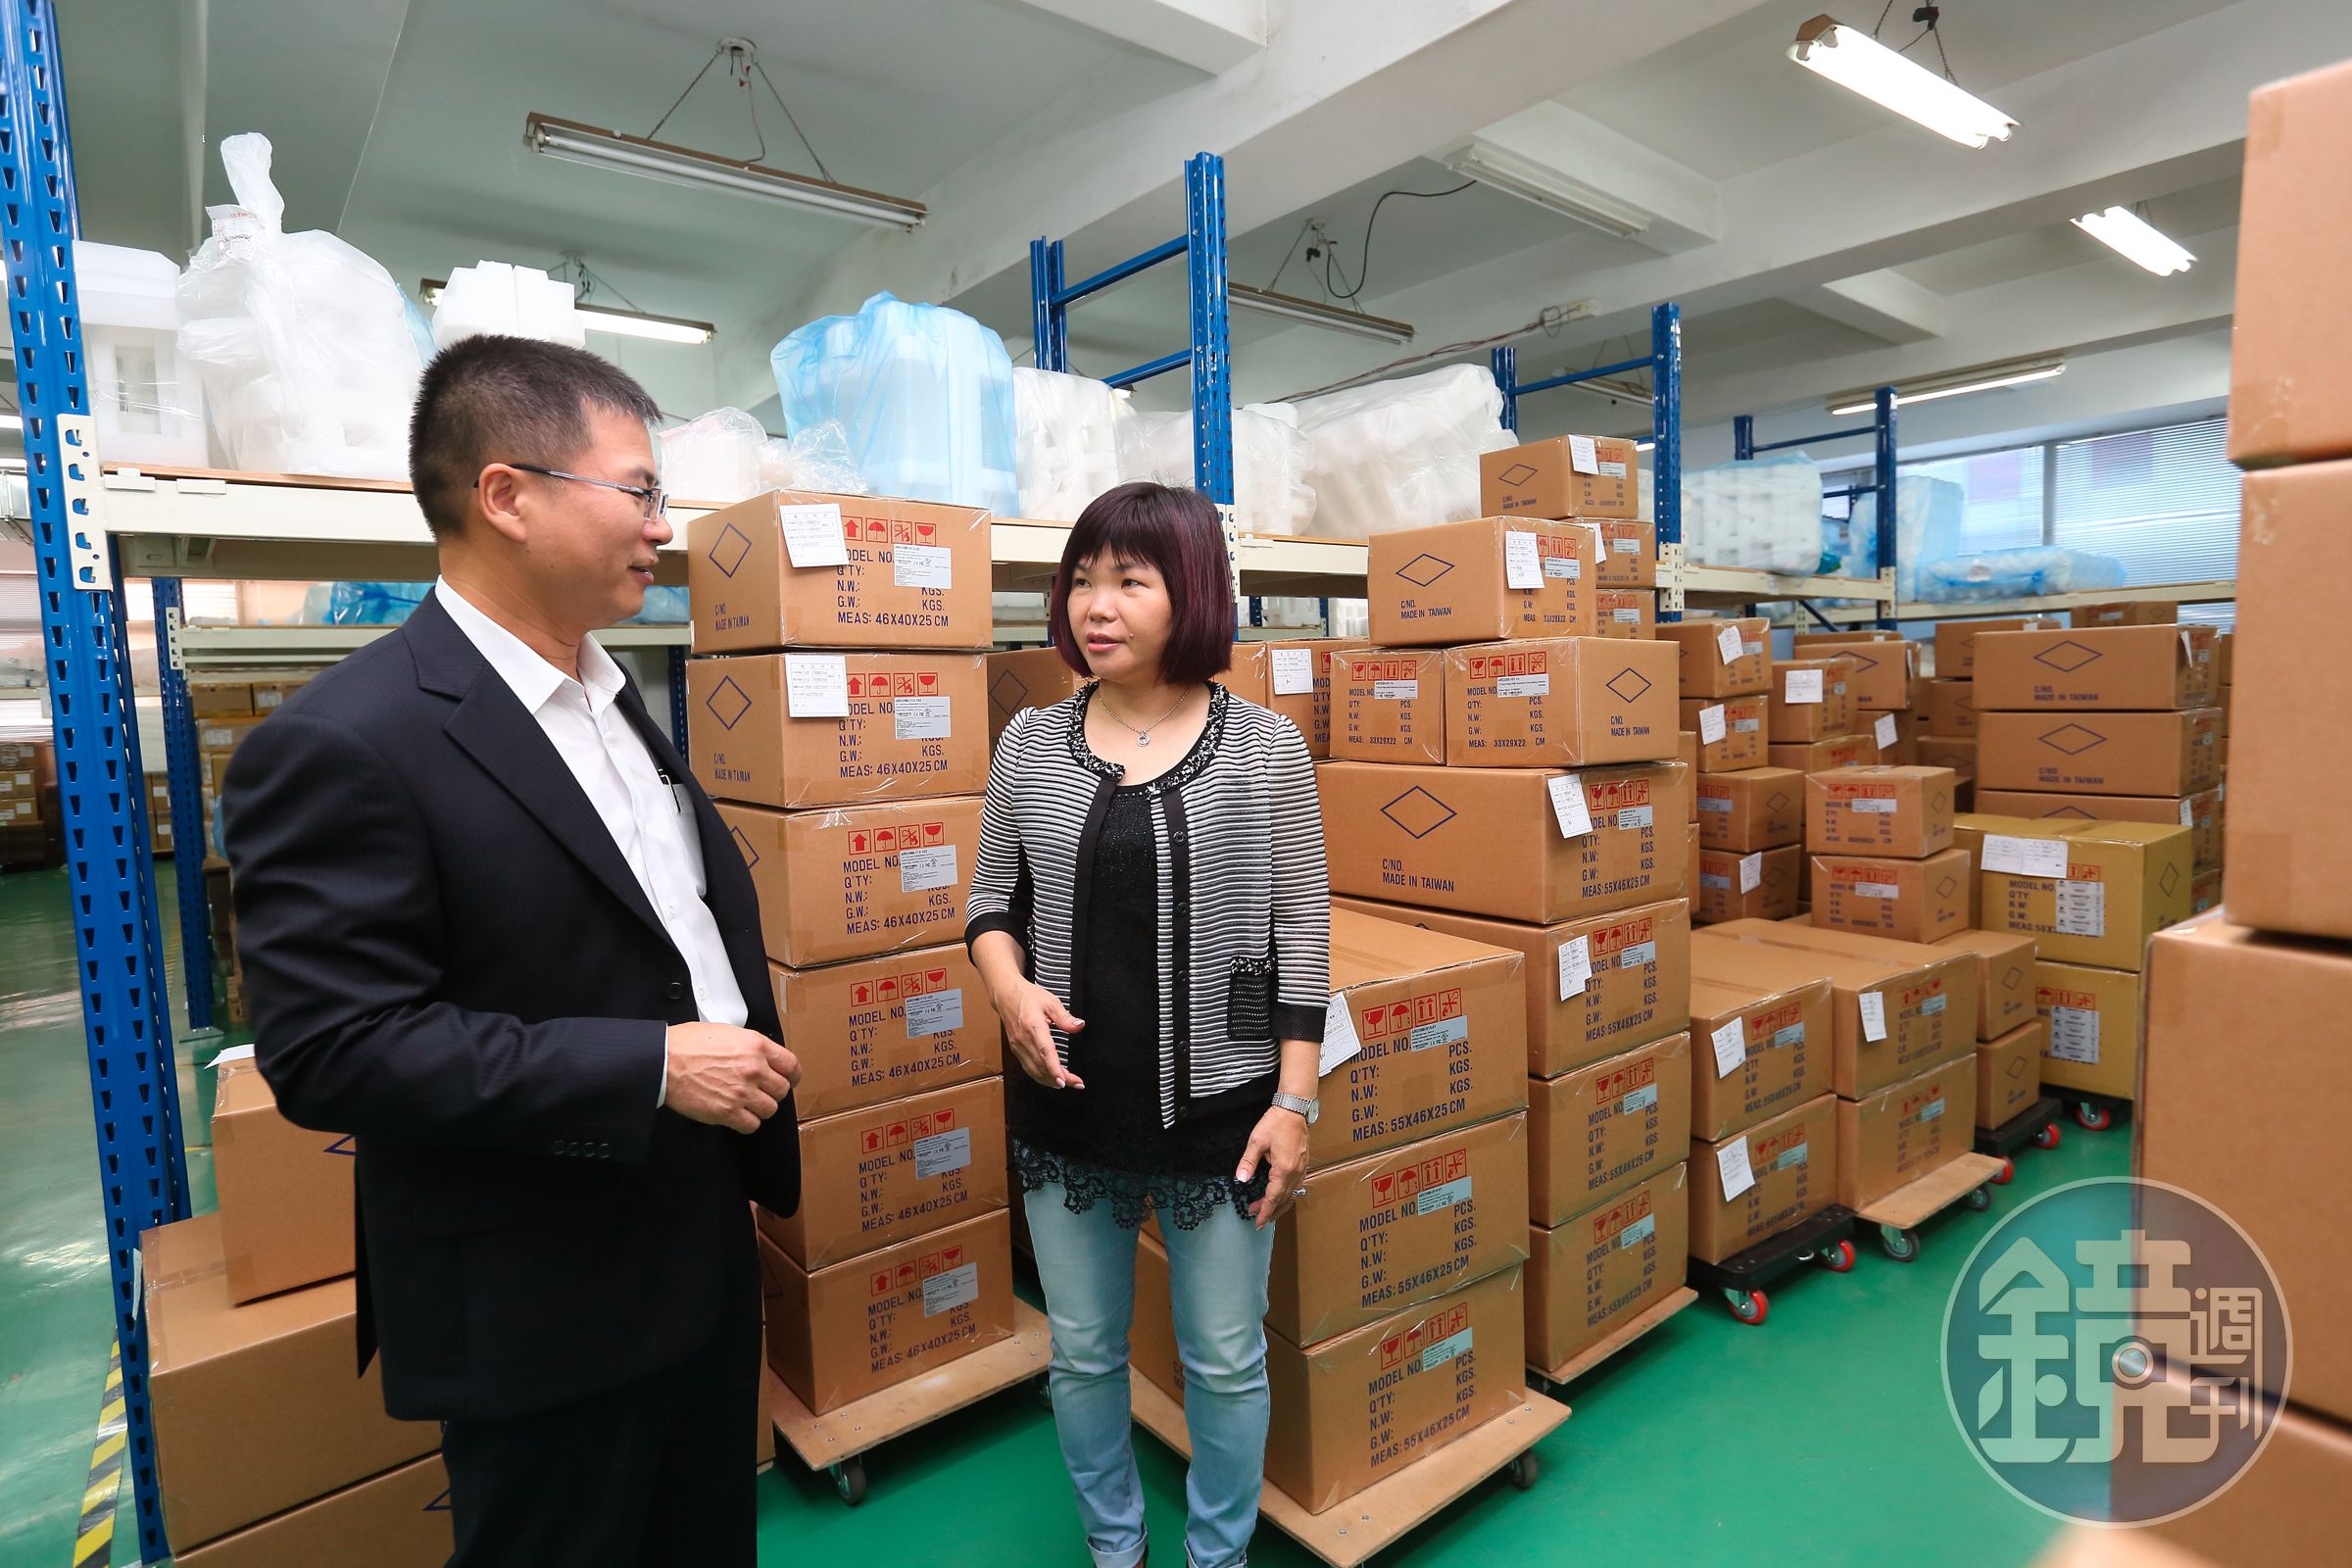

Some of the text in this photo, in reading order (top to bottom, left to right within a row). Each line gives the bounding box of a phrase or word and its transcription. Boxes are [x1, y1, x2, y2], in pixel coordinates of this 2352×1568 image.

[846, 549, 873, 562] ODEL
[838, 596, 945, 611] G.W.: KGS.
[1401, 611, 1417, 619] MADE
[1428, 608, 1451, 616] TAIWAN
[715, 615, 749, 631] MADE IN TAIWAN
[838, 612, 948, 626] MEAS: 46X40X25 CM
[1467, 687, 1487, 696] MODEL
[1529, 696, 1541, 705] PCS.
[848, 703, 874, 715] ODEL
[838, 719, 865, 731] Q'TY:
[1531, 723, 1543, 732] KGS.
[1611, 726, 1649, 736] MADE IN TAIWAN
[839, 734, 861, 747] N.W.:
[840, 745, 944, 762] G.W.: KGS.
[715, 768, 750, 782] MADE IN TAIWAN
[841, 760, 948, 778] MEAS: 46X40X25 CM
[1590, 816, 1606, 830] ODEL
[1582, 825, 1654, 847] Q'TY: PCS.
[1583, 841, 1653, 863] N.W: KGS.
[844, 856, 901, 873] MODEL NO.
[1383, 858, 1403, 871] C/NO.
[1583, 858, 1654, 881] G.W: KGS.
[845, 874, 872, 888] Q'TY:
[1383, 874, 1454, 892] MADE IN TAIWAN
[1583, 874, 1649, 899] MEAS: 55X46X25 CM
[846, 891, 867, 904] N.W.:
[847, 893, 951, 919] G.W.: KGS.
[847, 907, 955, 935] MEAS: 46X40X25 CM
[1592, 958, 1609, 974] ODEL
[1585, 960, 1657, 993] Q'TY: PCS.
[1586, 975, 1656, 1008] N.W: KGS.
[849, 1006, 906, 1027] MODEL NO.
[1586, 992, 1657, 1025] G.W: KGS.
[850, 1027, 877, 1042] Q'TY:
[1586, 1008, 1652, 1042] MEAS: 55X46X25 CM
[851, 1043, 872, 1056] N.W.:
[1394, 1037, 1411, 1053] NO.
[852, 1040, 956, 1071] G.W.: KGS.
[1350, 1041, 1472, 1084] Q'TY: PCS.
[852, 1053, 959, 1087] MEAS: 46X40X25 CM
[1351, 1058, 1472, 1102] N.W: KGS.
[1352, 1078, 1473, 1122] G.W: KGS.
[1353, 1098, 1465, 1142] MEAS: 55X46X25 CM
[1589, 1107, 1612, 1126] MODEL
[858, 1149, 915, 1174] MODEL NO.
[859, 1171, 887, 1189] Q'TY:
[942, 1178, 963, 1193] KGS.
[862, 1190, 967, 1233] MEAS: 46X40X25 CM
[1360, 1201, 1418, 1233] MODEL NO.
[1360, 1231, 1388, 1251] Q'TY:
[1454, 1200, 1476, 1217] PCS.
[1361, 1217, 1476, 1269] N.W: KGS.
[1361, 1235, 1477, 1289] G.W: KGS.
[1362, 1254, 1469, 1308] MEAS: 55X46X25 CM
[867, 1296, 905, 1316] MODEL
[869, 1314, 896, 1331] Q'TY:
[951, 1311, 971, 1327] KGS.
[870, 1323, 975, 1373] MEAS: 46X40X25 CM
[1369, 1392, 1395, 1414] Q'TY:
[1455, 1350, 1476, 1370] PCS.
[1369, 1372, 1404, 1396] MODEL
[1370, 1367, 1476, 1433] N.W: KGS.
[1370, 1385, 1477, 1449] G.W: KGS.
[1370, 1404, 1469, 1467] MEAS: 55X46X25 CM
